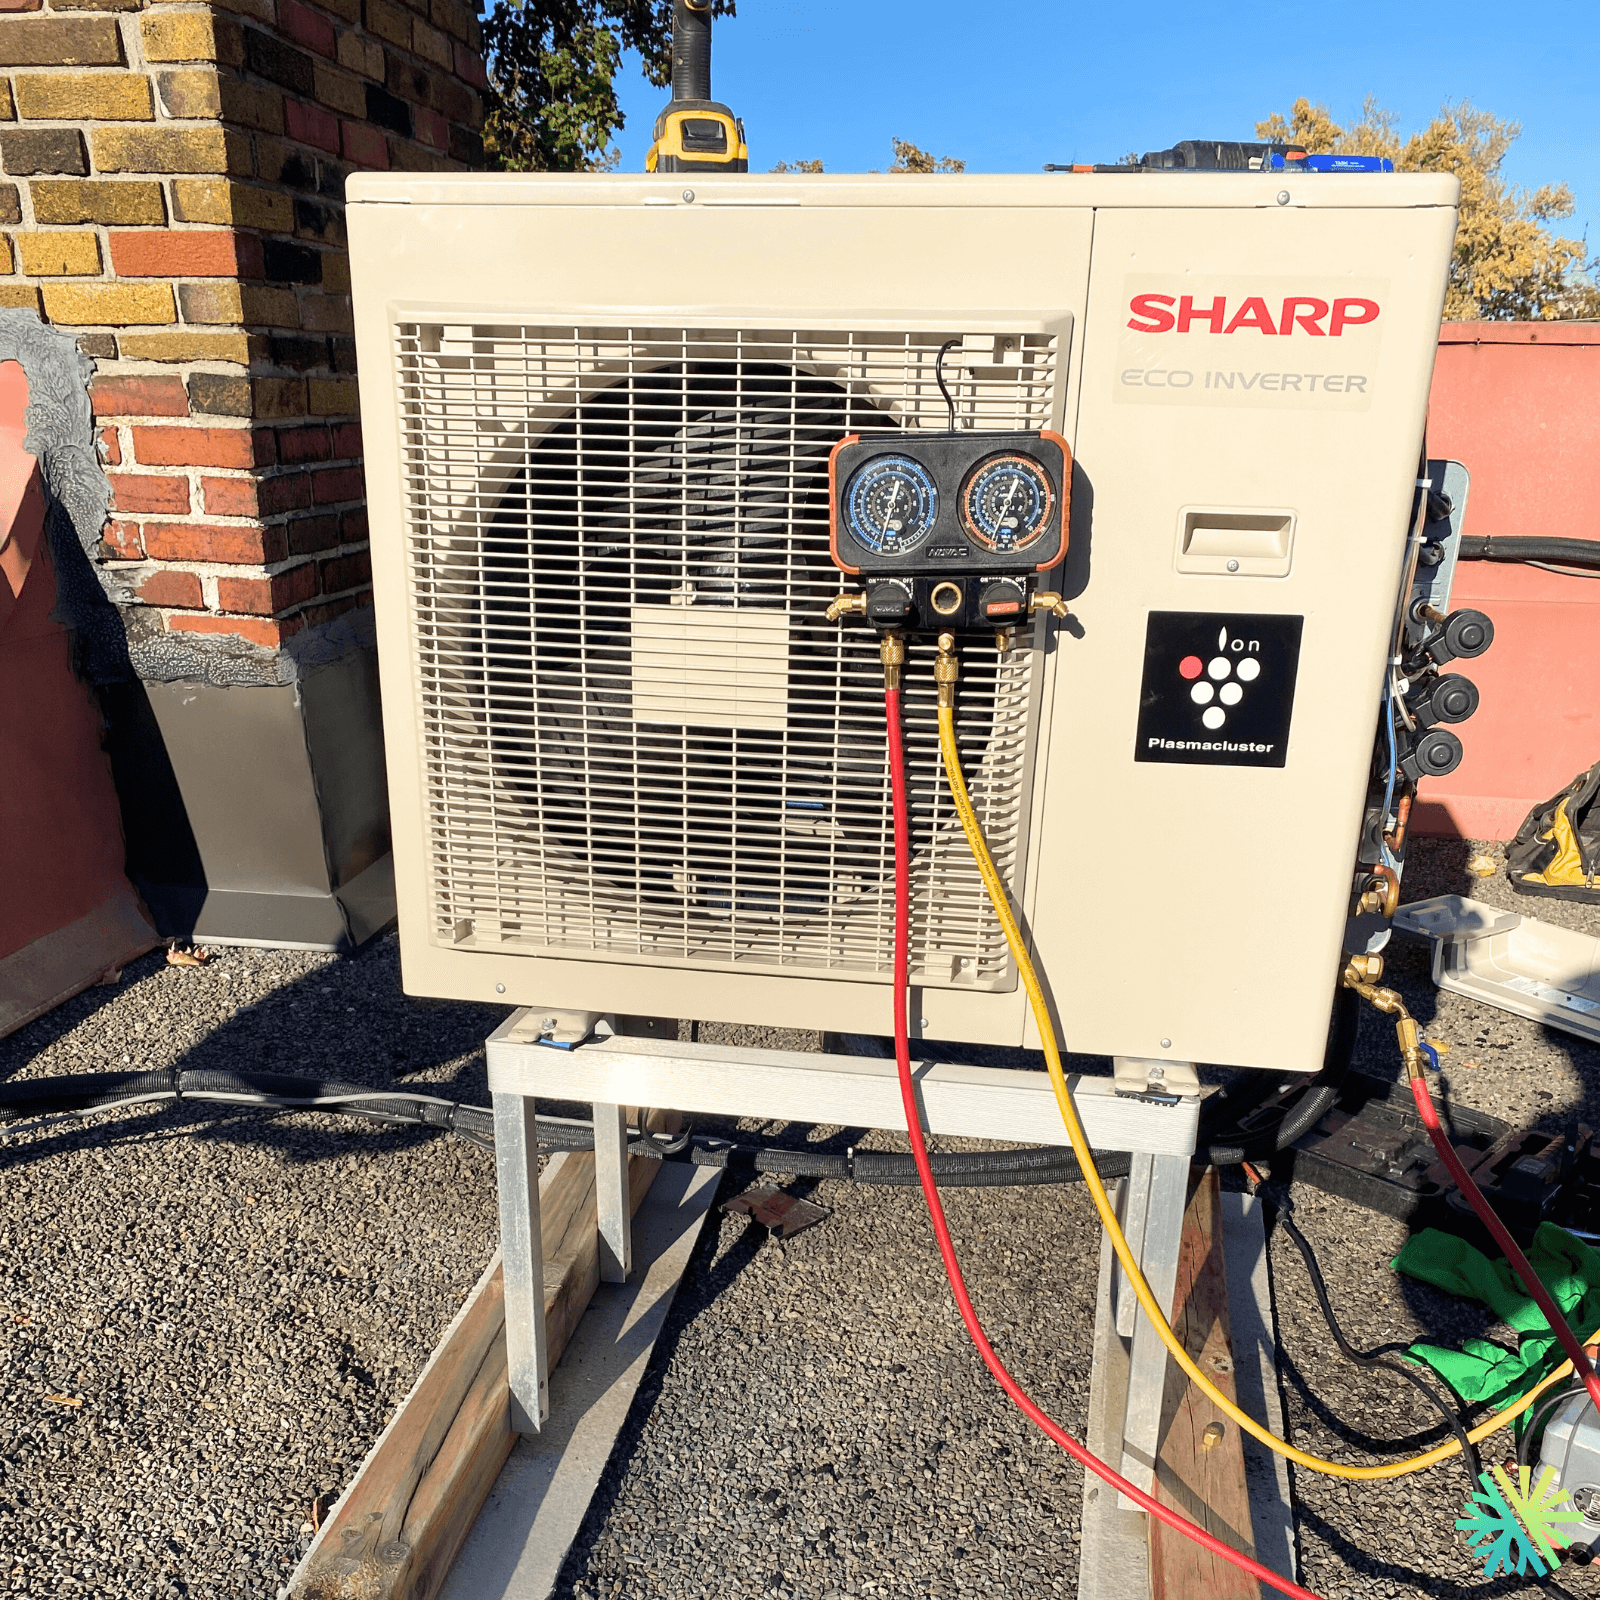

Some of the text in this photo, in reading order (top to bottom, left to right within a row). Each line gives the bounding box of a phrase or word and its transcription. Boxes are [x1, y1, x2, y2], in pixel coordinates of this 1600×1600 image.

[1126, 293, 1380, 337] SHARP
[1120, 368, 1368, 393] ECO INVERTER
[1218, 625, 1260, 652] Ion
[1148, 737, 1275, 753] Plasmacluster
